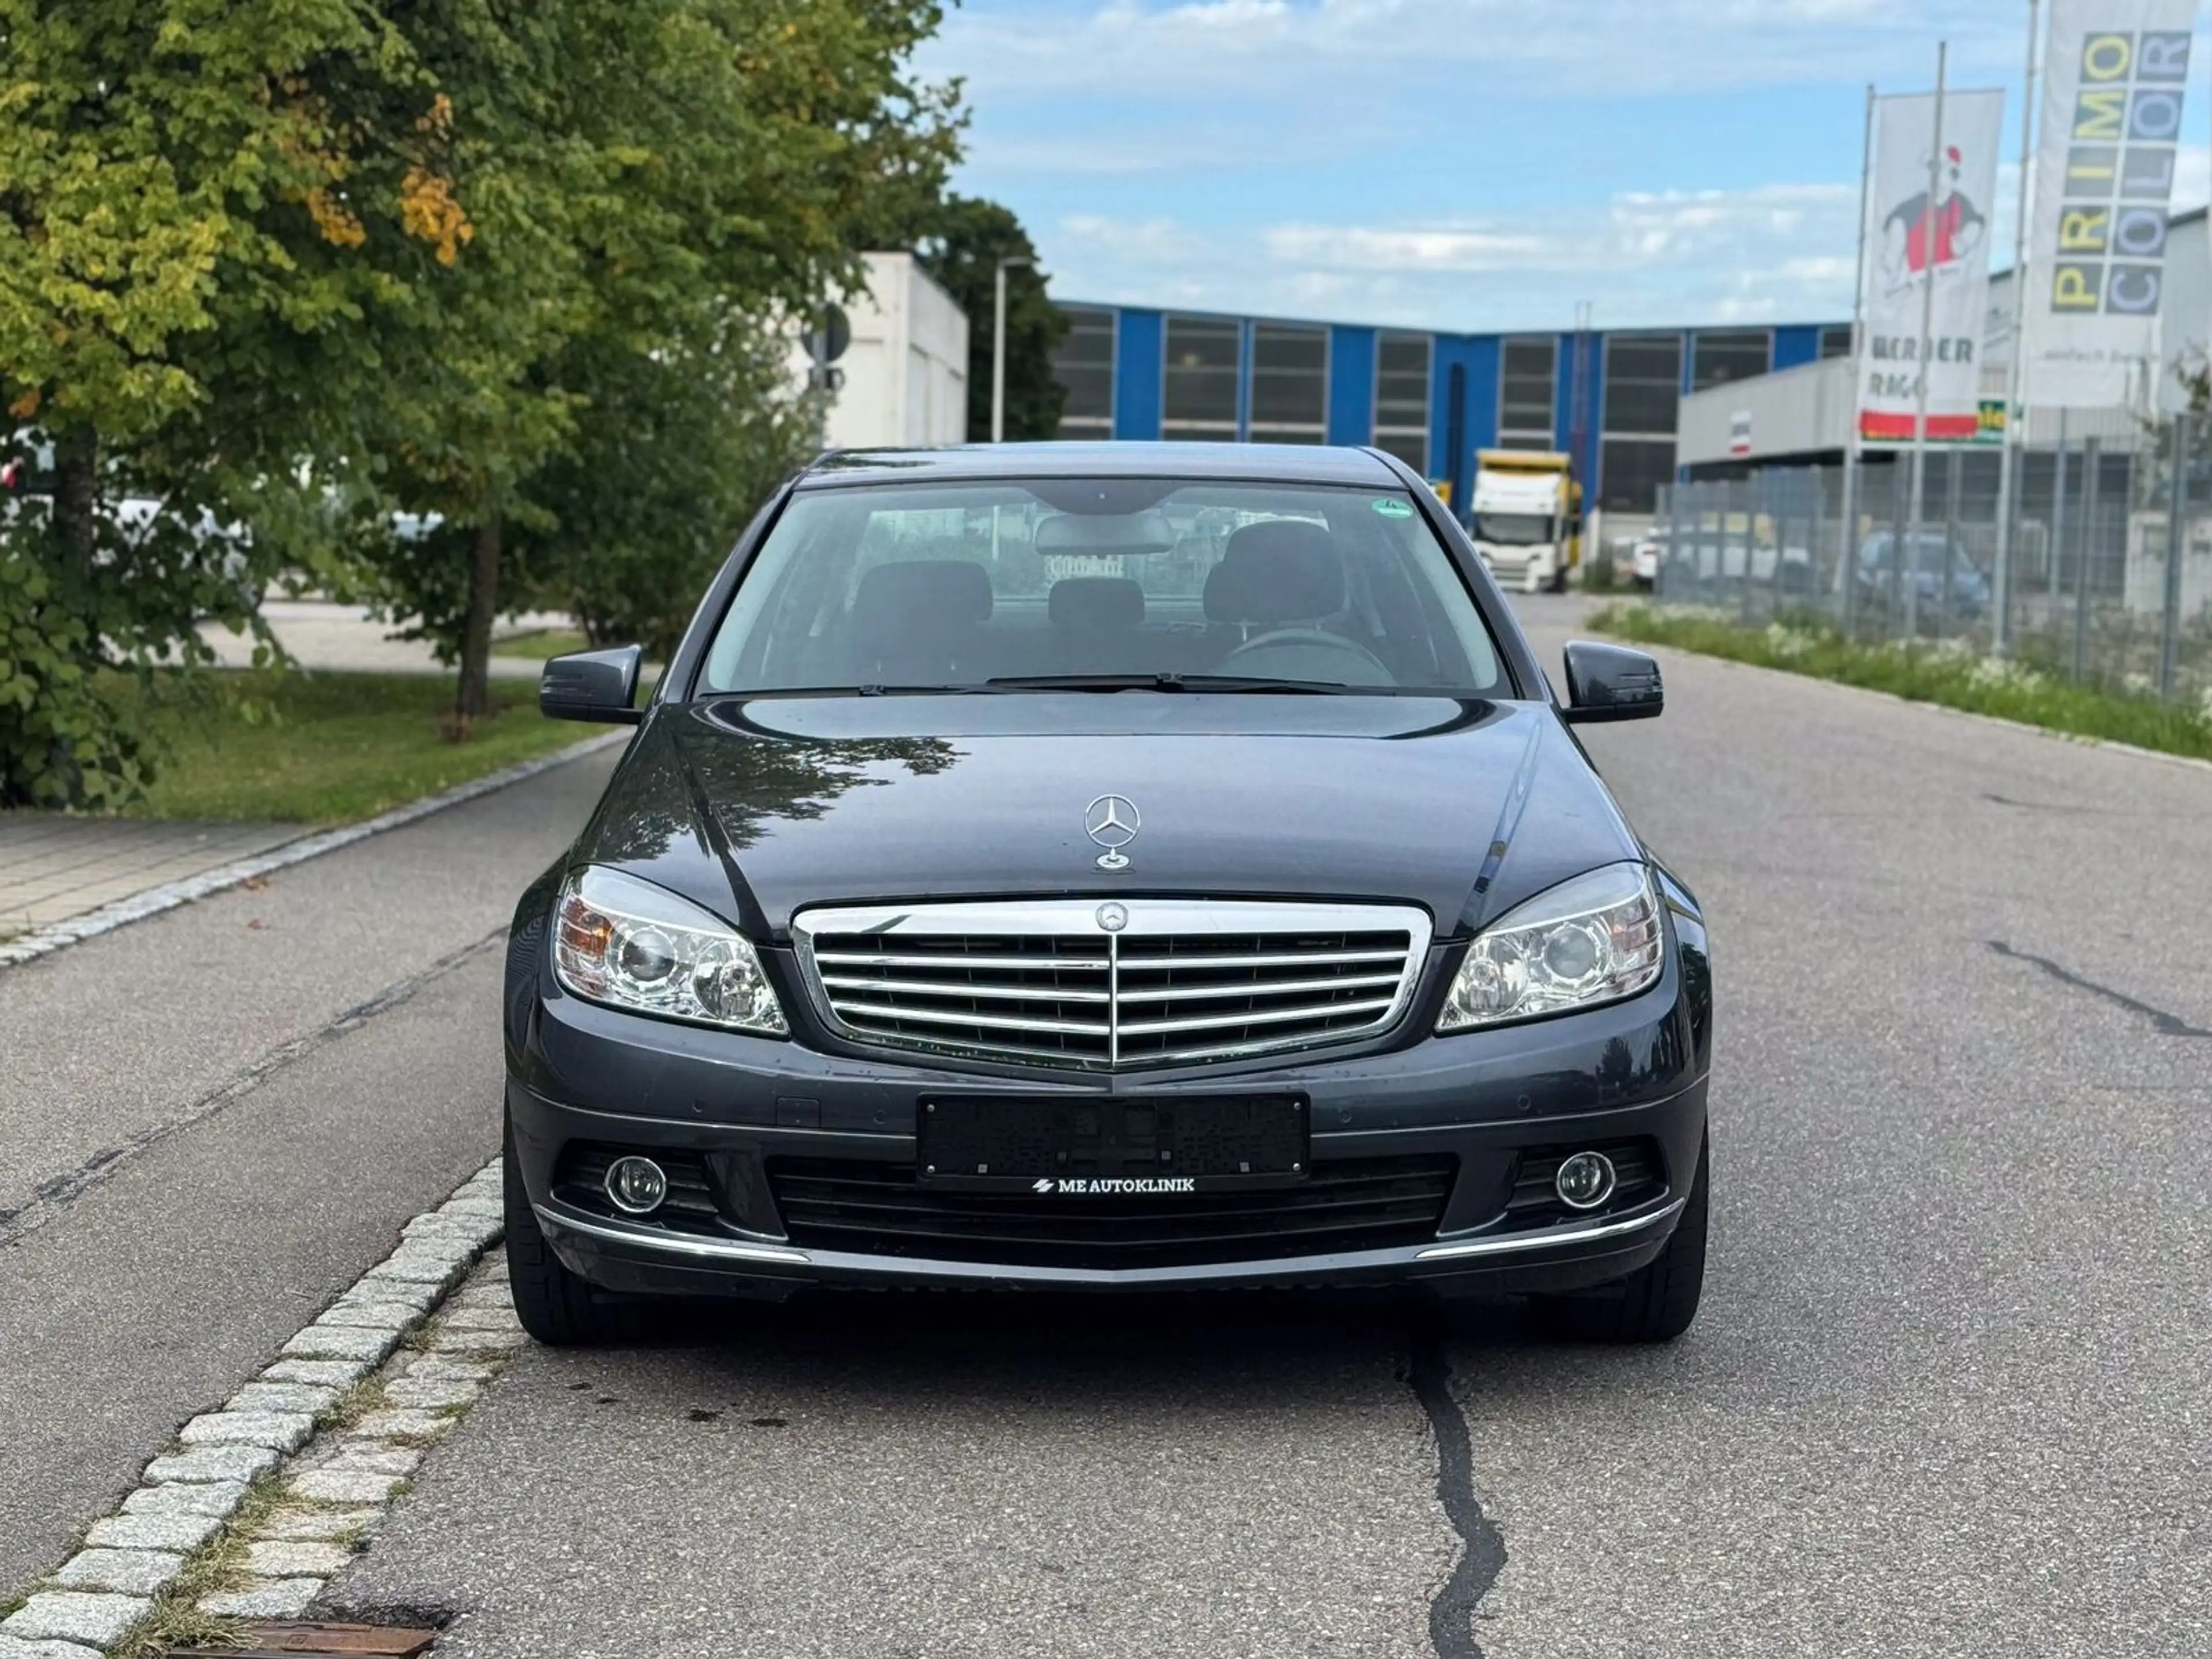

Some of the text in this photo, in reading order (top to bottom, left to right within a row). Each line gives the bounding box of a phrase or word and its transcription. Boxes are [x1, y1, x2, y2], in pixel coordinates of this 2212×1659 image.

[2054, 35, 2130, 308] PRIMO
[2105, 35, 2187, 311] COLOR
[1059, 1178, 1195, 1192] ME AUTOKLINIK
